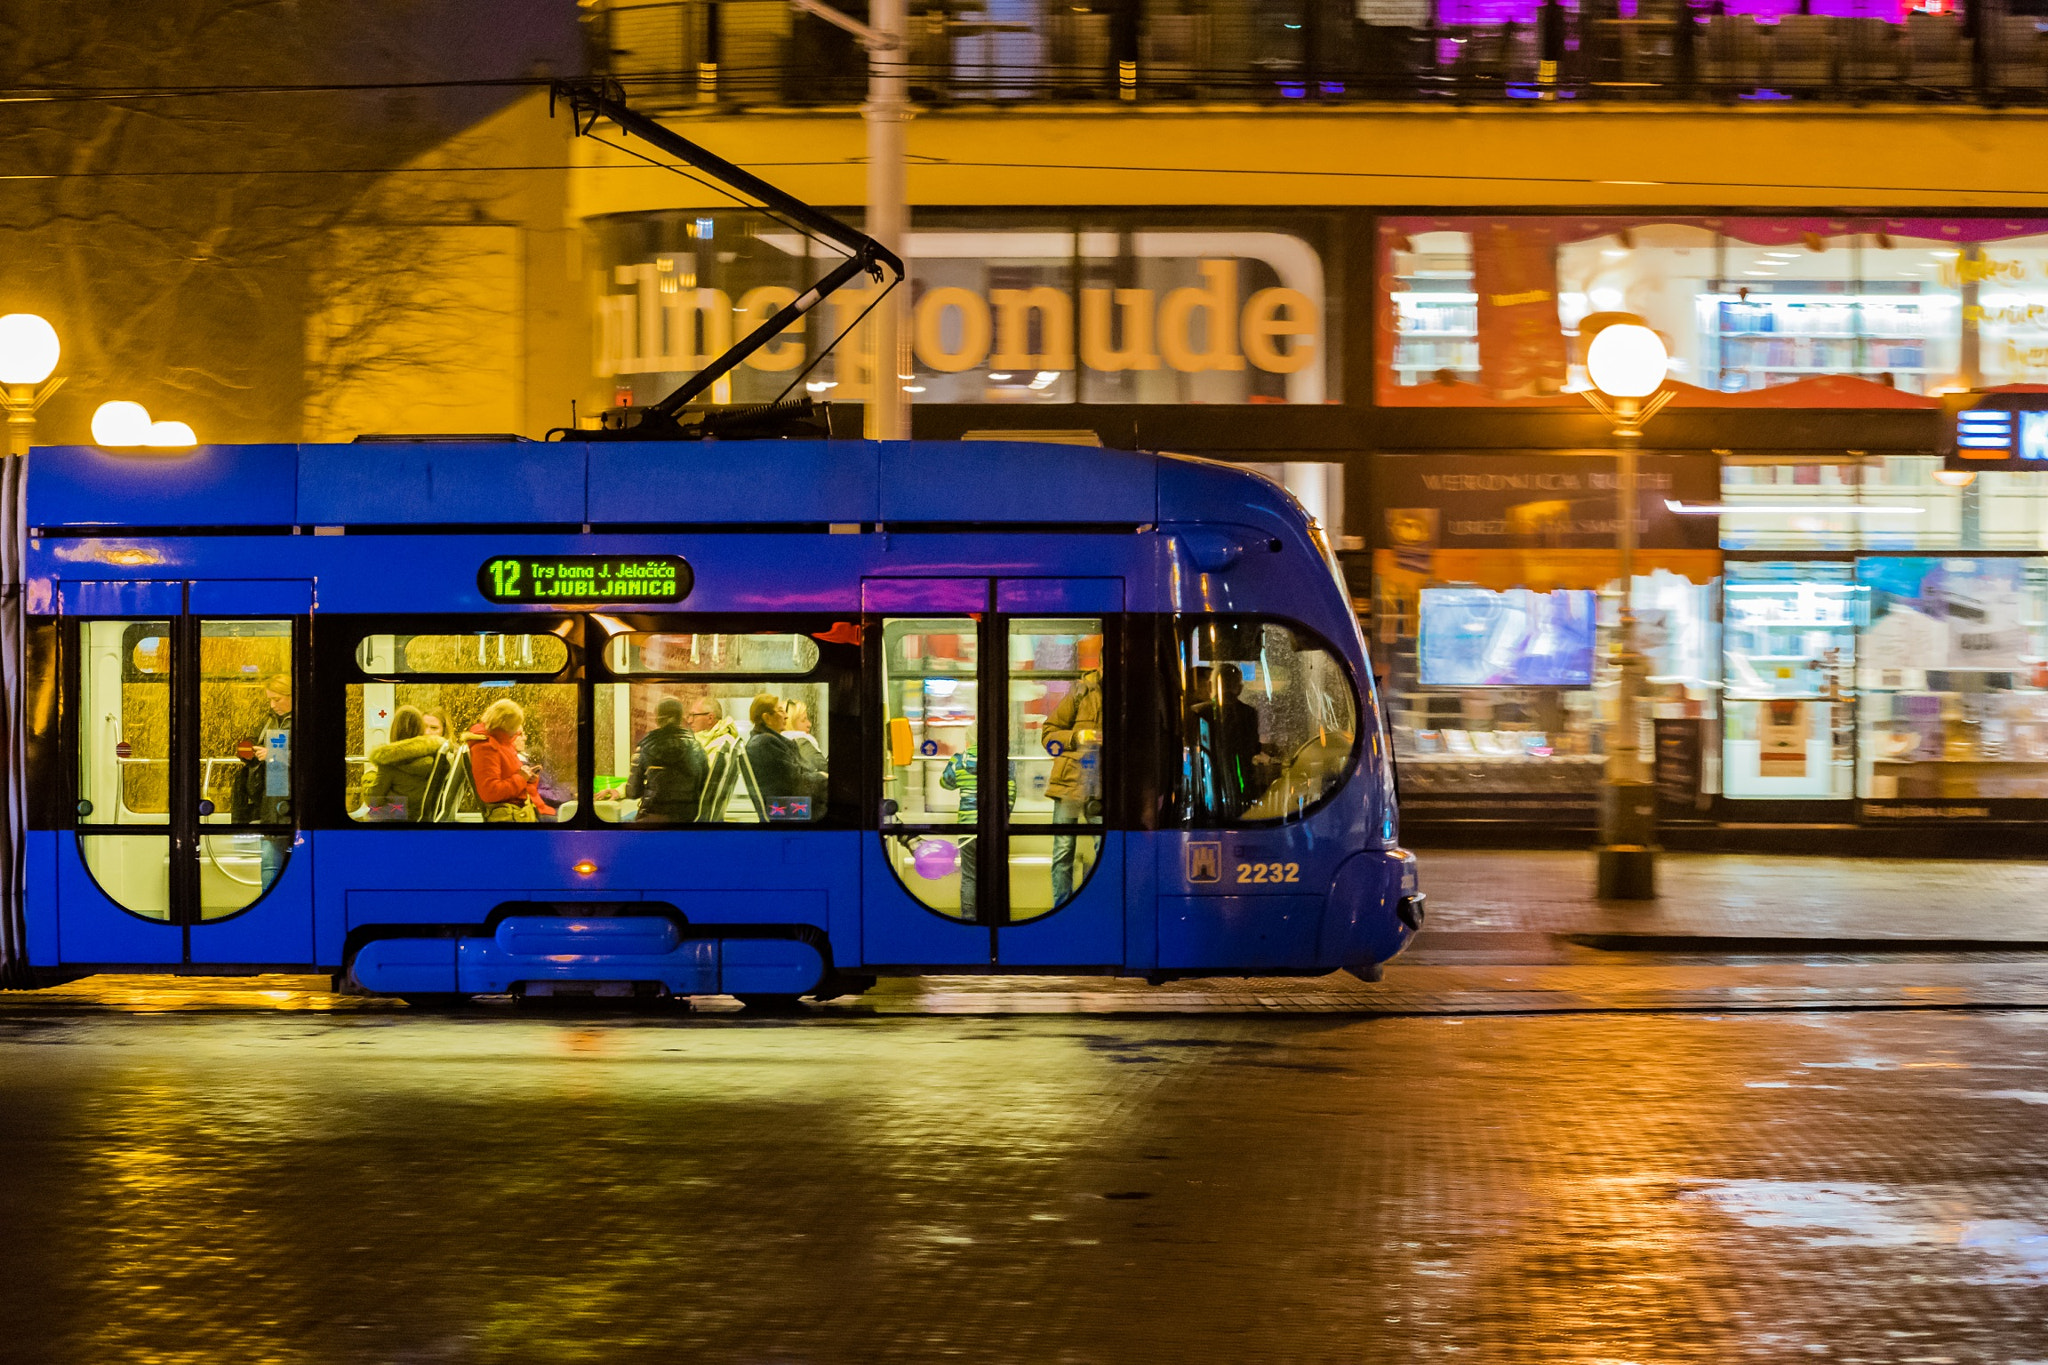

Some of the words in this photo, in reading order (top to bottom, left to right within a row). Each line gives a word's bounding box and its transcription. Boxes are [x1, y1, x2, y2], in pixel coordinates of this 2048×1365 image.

[824, 258, 1317, 400] ponude
[489, 560, 521, 596] 12
[531, 564, 555, 578] Trg
[558, 564, 594, 578] bana
[598, 564, 612, 578] J.
[615, 561, 676, 578] Jelačića
[534, 580, 676, 596] LJUBLJANICA
[1236, 862, 1300, 884] 2232
